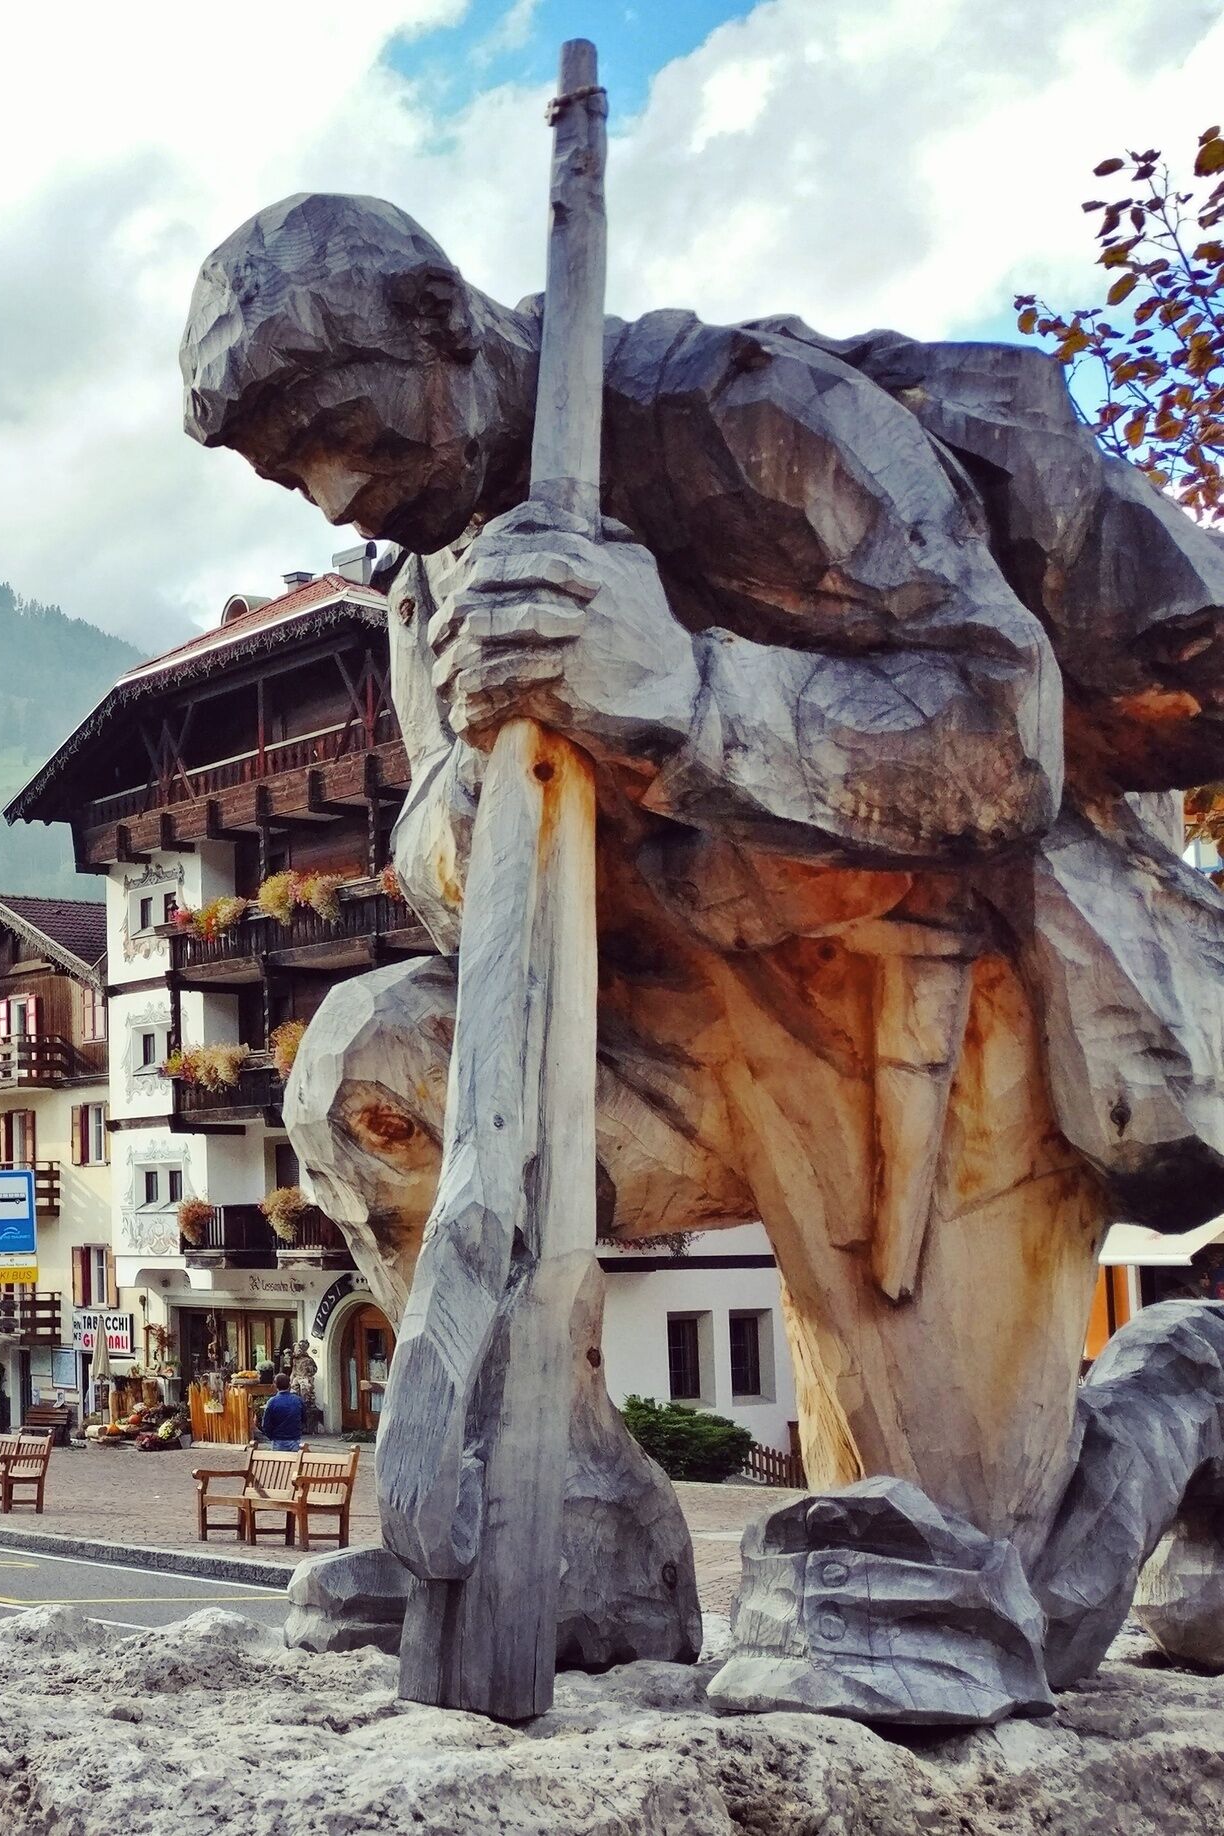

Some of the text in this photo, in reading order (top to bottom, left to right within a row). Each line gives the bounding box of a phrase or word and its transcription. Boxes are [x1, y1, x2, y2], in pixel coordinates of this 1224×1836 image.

[12, 1270, 32, 1280] BUS
[83, 1315, 128, 1331] TABCCHI
[83, 1333, 128, 1350] GINALI
